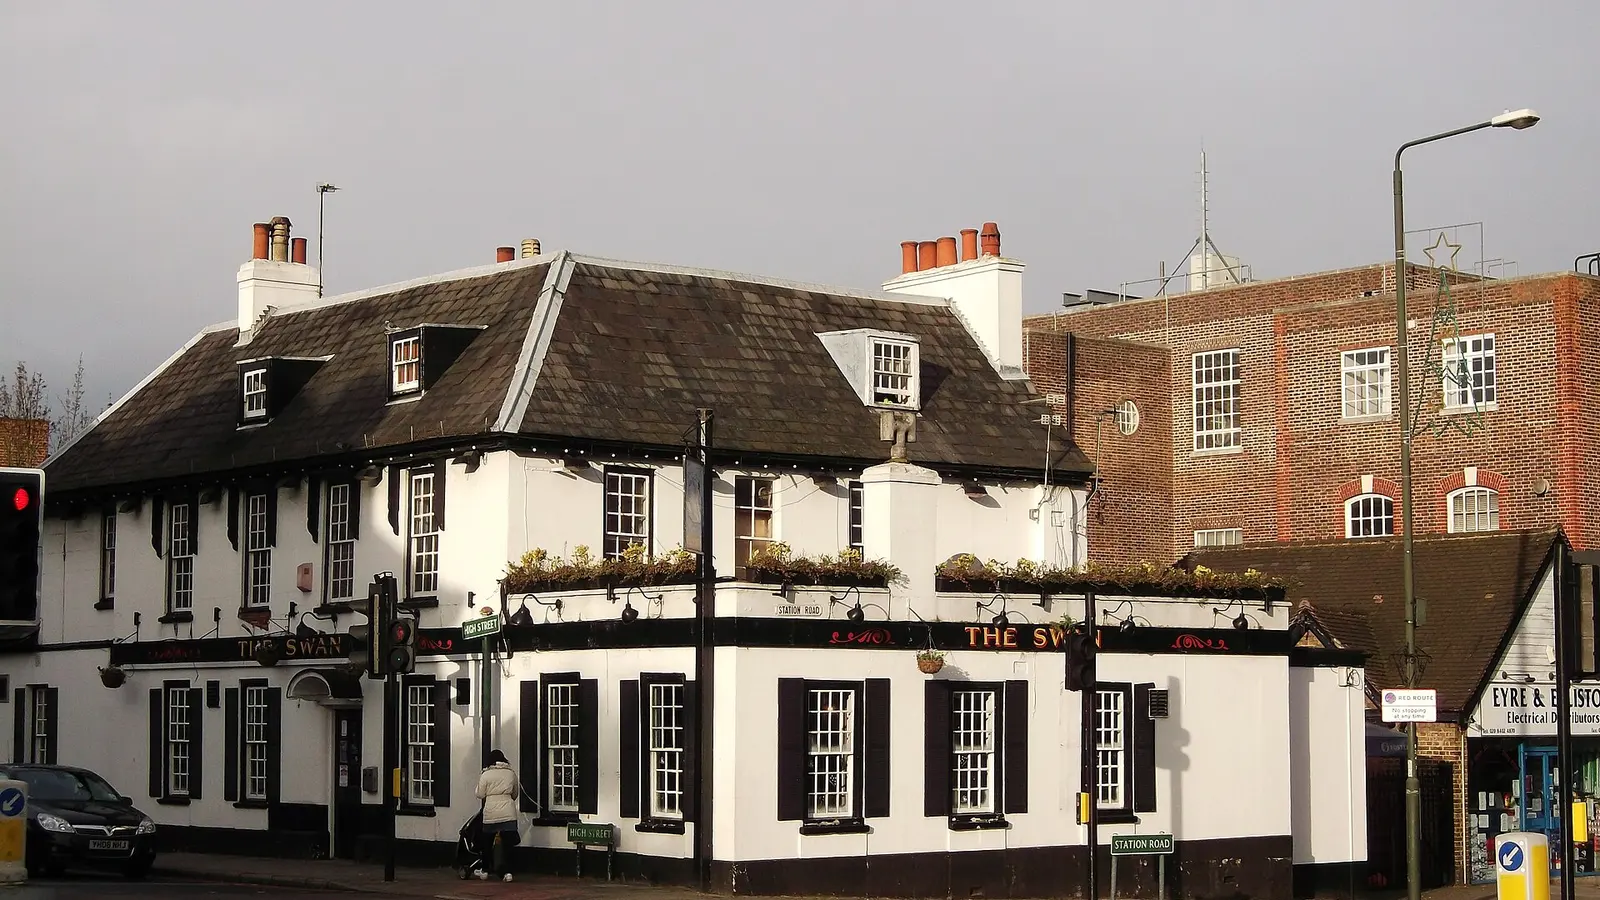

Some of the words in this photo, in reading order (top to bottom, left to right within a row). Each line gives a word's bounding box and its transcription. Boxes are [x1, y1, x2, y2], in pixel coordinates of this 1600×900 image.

[778, 605, 801, 614] STATION
[804, 605, 820, 614] ROAD
[464, 622, 476, 636] HIGH
[477, 618, 498, 631] STREET
[965, 627, 1018, 648] THE
[1033, 627, 1103, 648] SW
[286, 636, 341, 656] SWAN
[1493, 687, 1528, 707] EYRE
[1533, 688, 1546, 707] &
[1551, 688, 1600, 708] EISTO
[1507, 711, 1548, 724] Electrical
[1551, 711, 1600, 724] Dibutors
[570, 828, 587, 838] HIGH
[589, 829, 612, 838] STREET
[1114, 839, 1147, 849] STATION
[1149, 838, 1170, 848] ROAD
